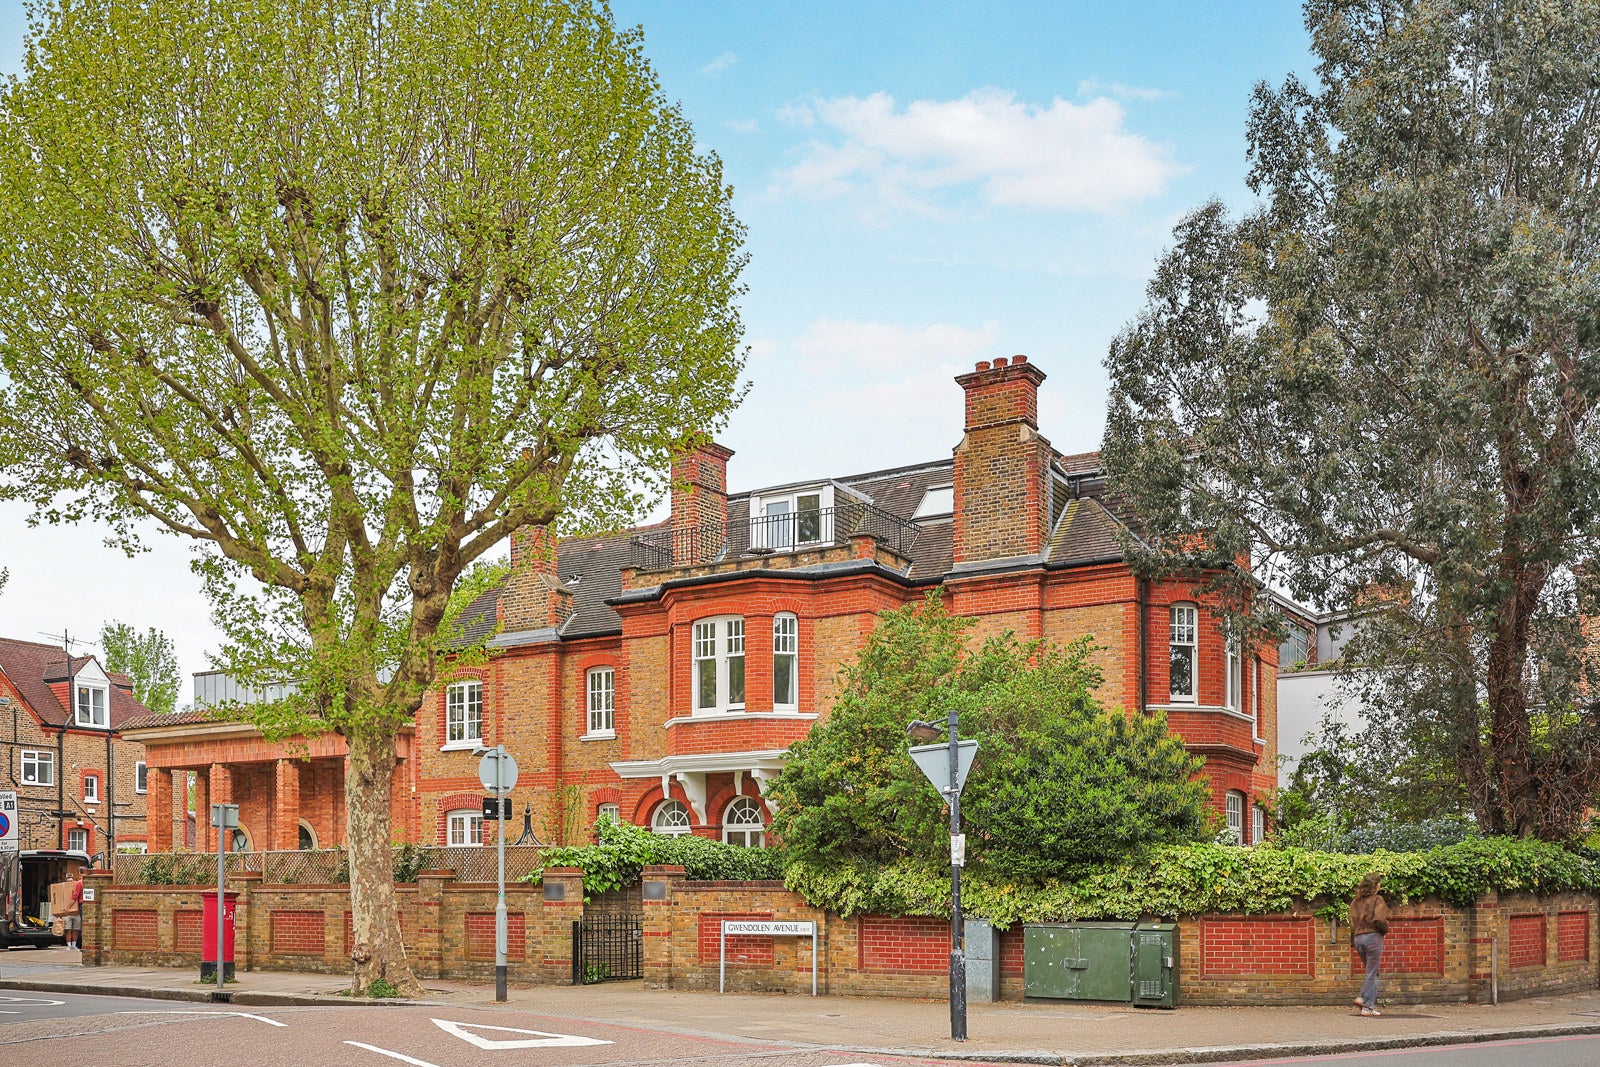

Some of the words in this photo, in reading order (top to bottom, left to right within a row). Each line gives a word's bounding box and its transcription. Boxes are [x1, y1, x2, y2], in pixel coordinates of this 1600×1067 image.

[6, 801, 14, 809] A1
[728, 924, 770, 932] GWENDOLEN
[773, 924, 799, 932] AVENUE
